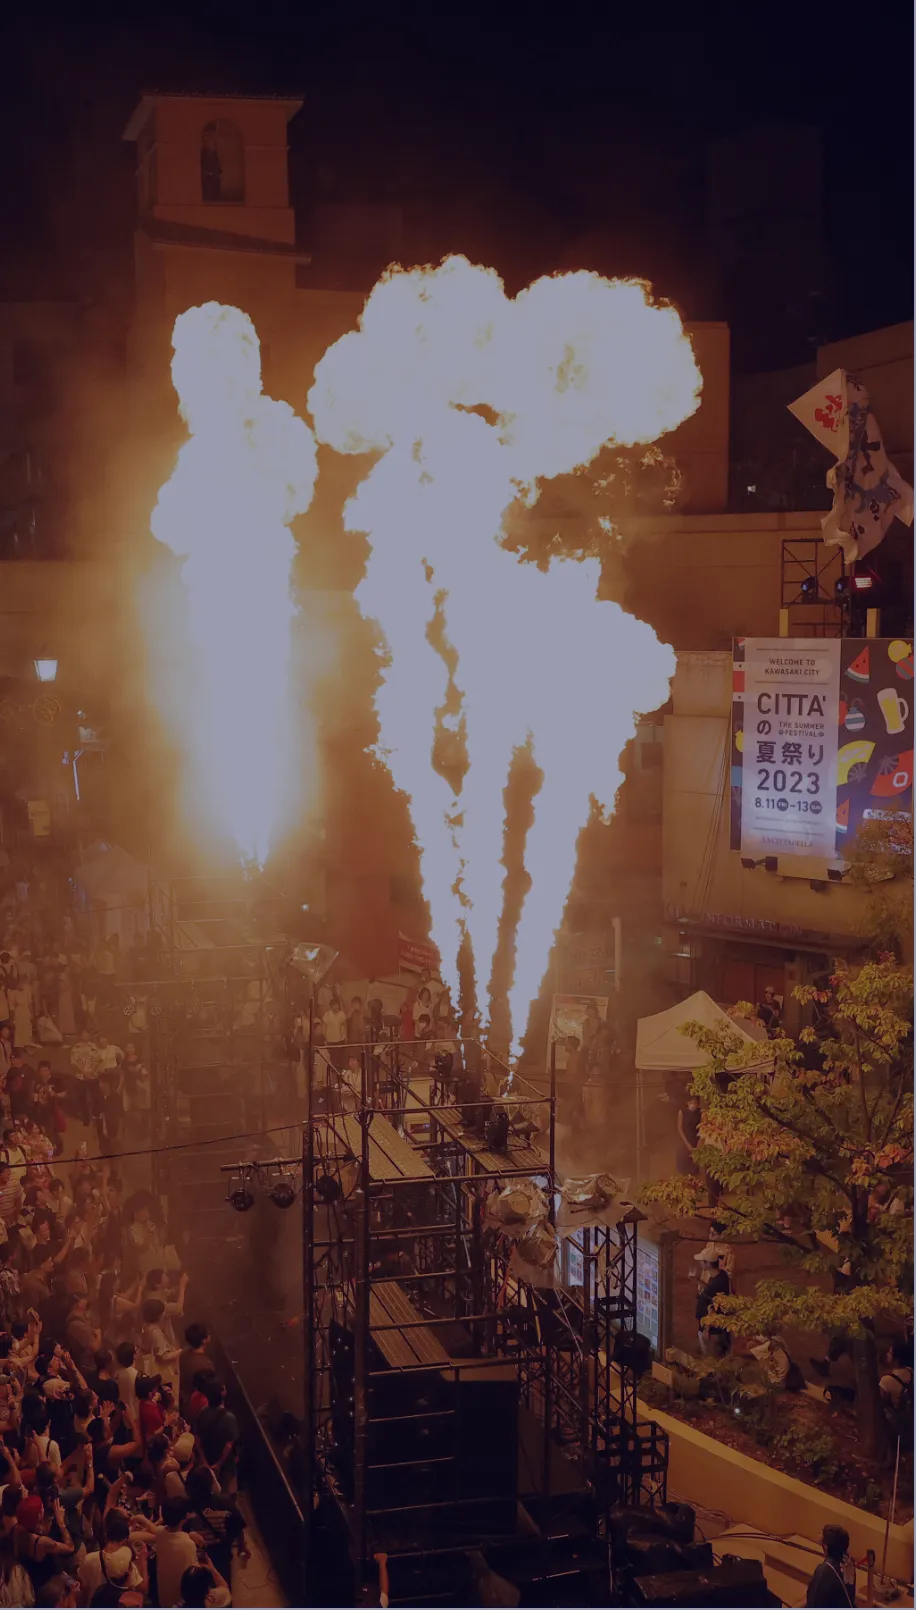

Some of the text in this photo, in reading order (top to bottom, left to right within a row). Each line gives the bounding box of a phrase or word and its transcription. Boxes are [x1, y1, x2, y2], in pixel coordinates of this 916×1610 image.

[769, 658, 804, 666] WELCOME
[757, 692, 826, 717] CITTA'
[756, 719, 772, 736] の
[779, 721, 825, 730] THE SUMMER
[784, 729, 817, 738] FESTIVAL
[756, 740, 824, 766] 夏祭り
[756, 768, 820, 795] 2023
